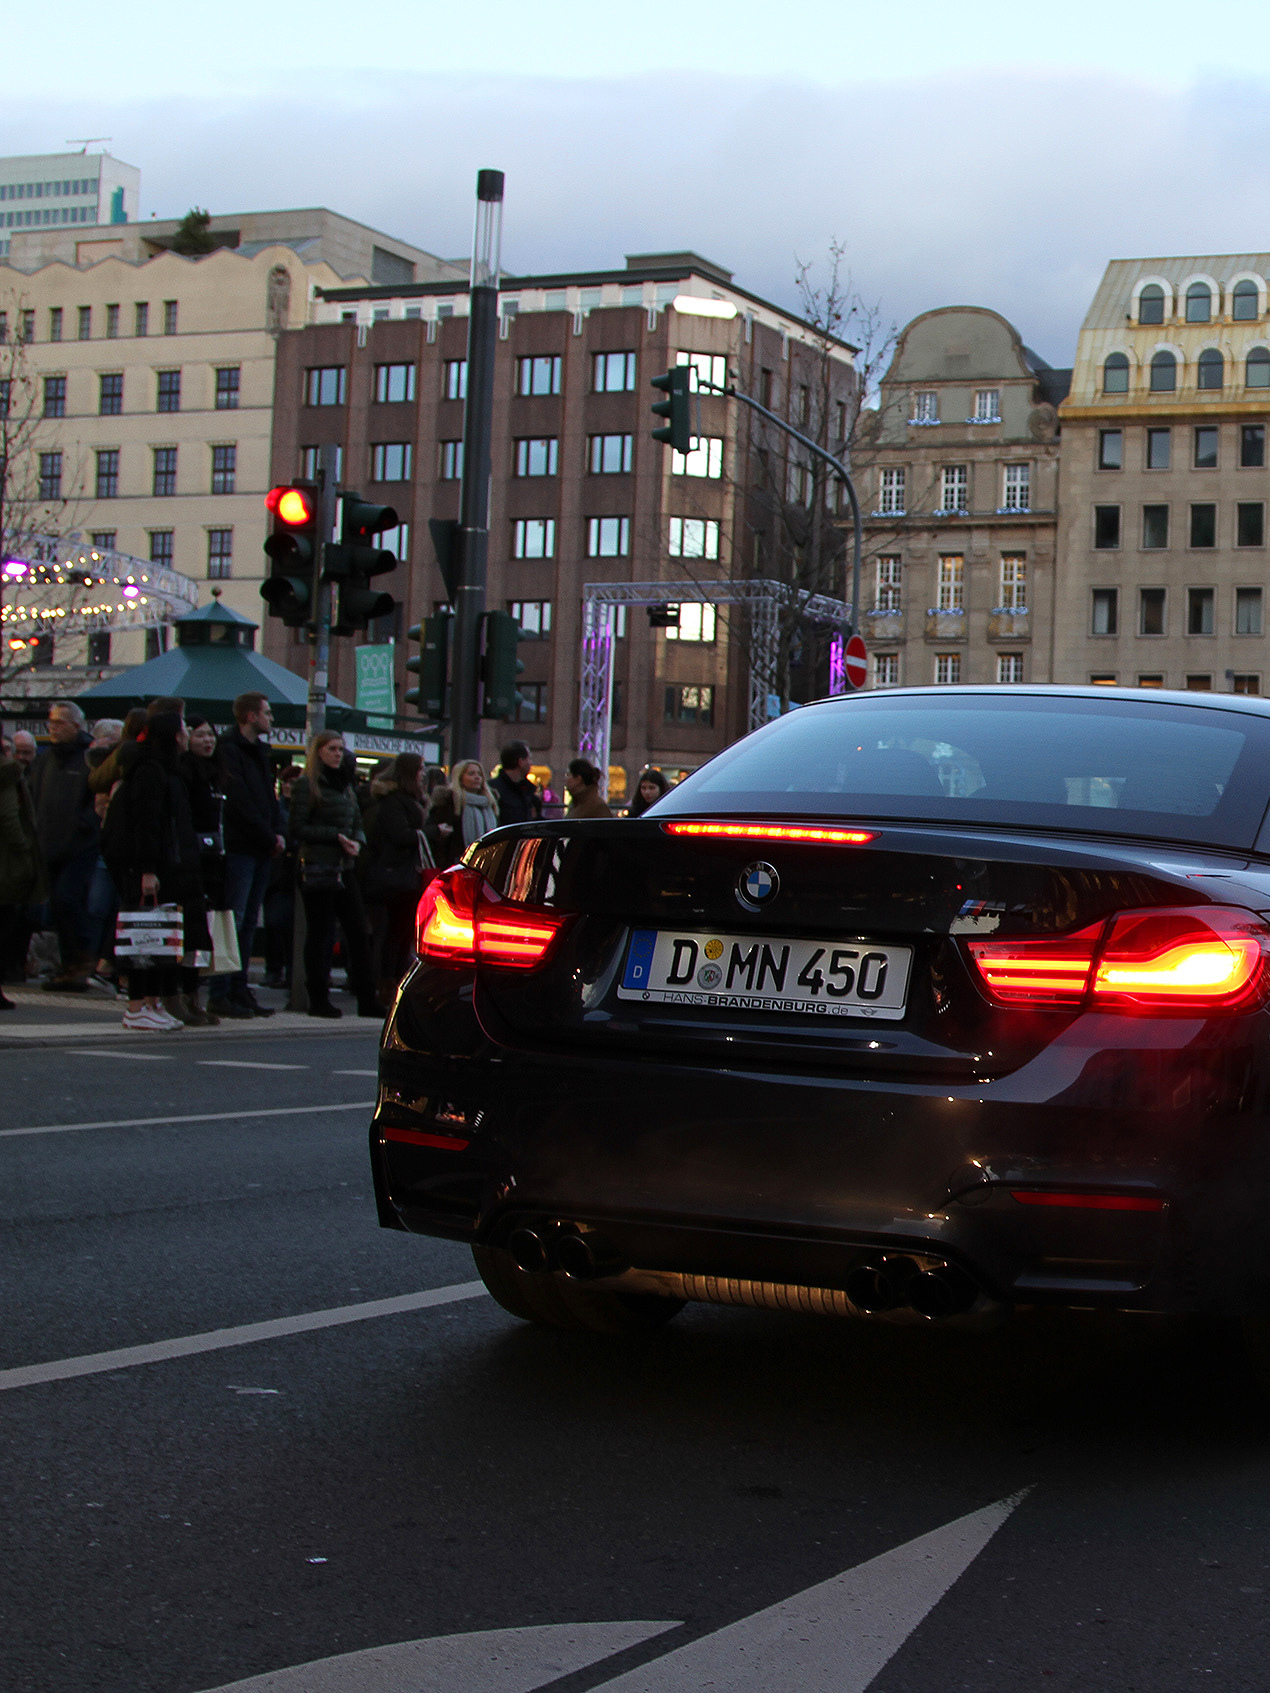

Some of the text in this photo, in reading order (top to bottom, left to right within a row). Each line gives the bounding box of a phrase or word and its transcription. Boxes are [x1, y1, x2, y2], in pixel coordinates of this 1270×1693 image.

[267, 729, 307, 744] POST
[632, 965, 643, 978] D
[666, 939, 889, 1000] D MN 450
